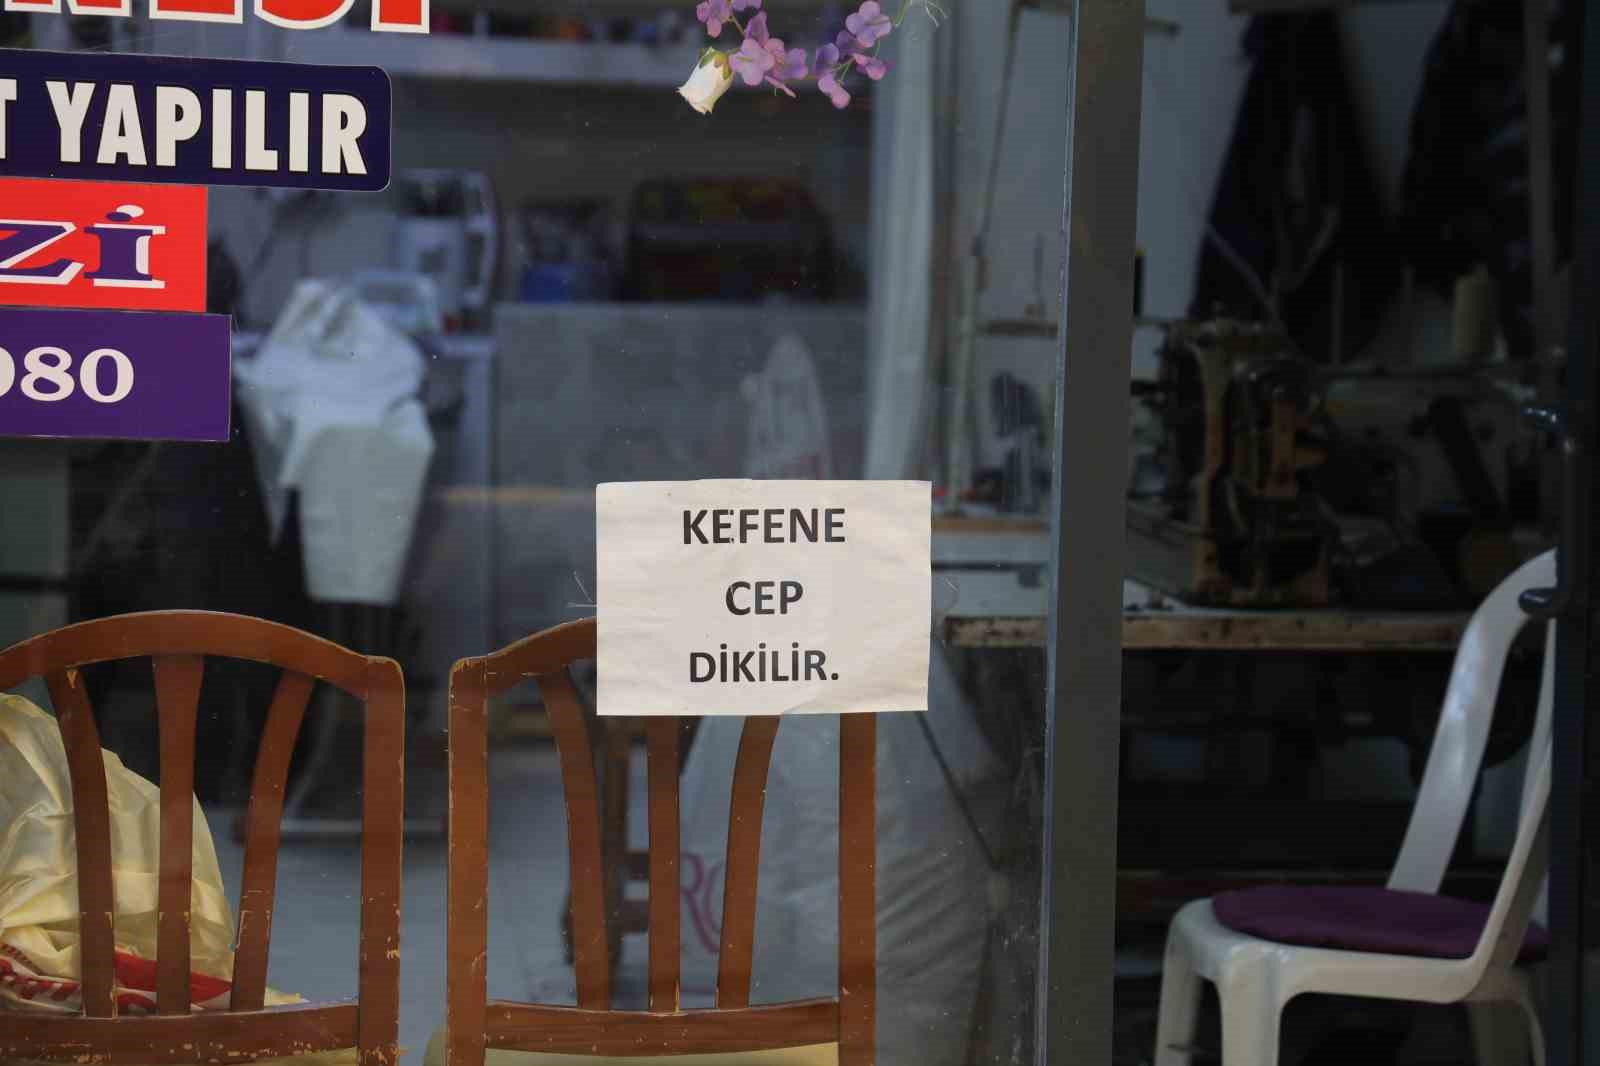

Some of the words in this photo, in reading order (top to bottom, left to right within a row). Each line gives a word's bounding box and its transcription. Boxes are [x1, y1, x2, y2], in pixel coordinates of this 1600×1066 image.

[45, 80, 368, 175] YAPILIR
[0, 345, 135, 404] 80
[682, 508, 846, 545] KEFENE
[725, 580, 804, 616] CEP
[689, 642, 839, 683] DİKİLİR.
